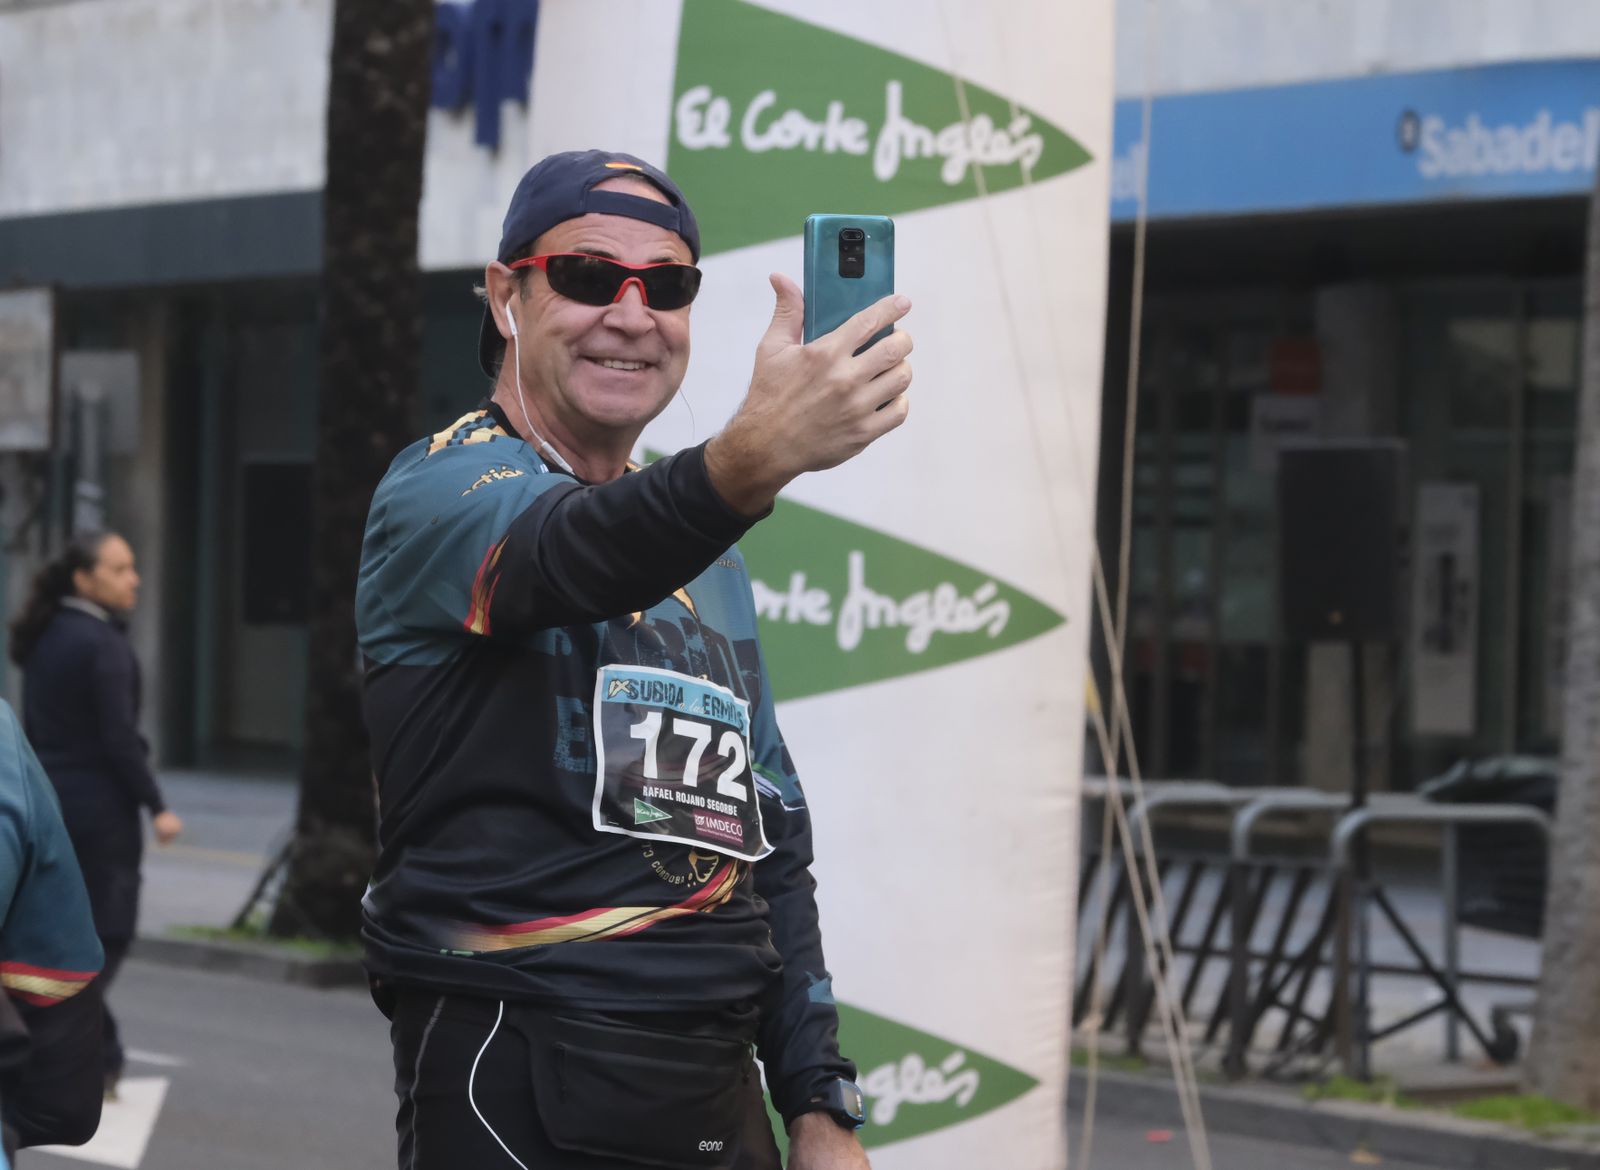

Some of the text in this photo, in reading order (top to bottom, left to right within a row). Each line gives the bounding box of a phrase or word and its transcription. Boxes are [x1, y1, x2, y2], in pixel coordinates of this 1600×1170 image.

[676, 86, 731, 150] El
[741, 89, 868, 154] Corte
[873, 80, 1043, 185] Inglés
[1418, 107, 1600, 178] Sabadel
[751, 550, 1010, 653] rte Inglés
[626, 679, 684, 708] SUBIDA
[630, 711, 748, 802] 172
[642, 785, 738, 817] RAFAEL ROJANO SEGORBE
[705, 816, 743, 837] IMDECO
[857, 1052, 979, 1126] glés
[698, 1140, 723, 1151] eono
